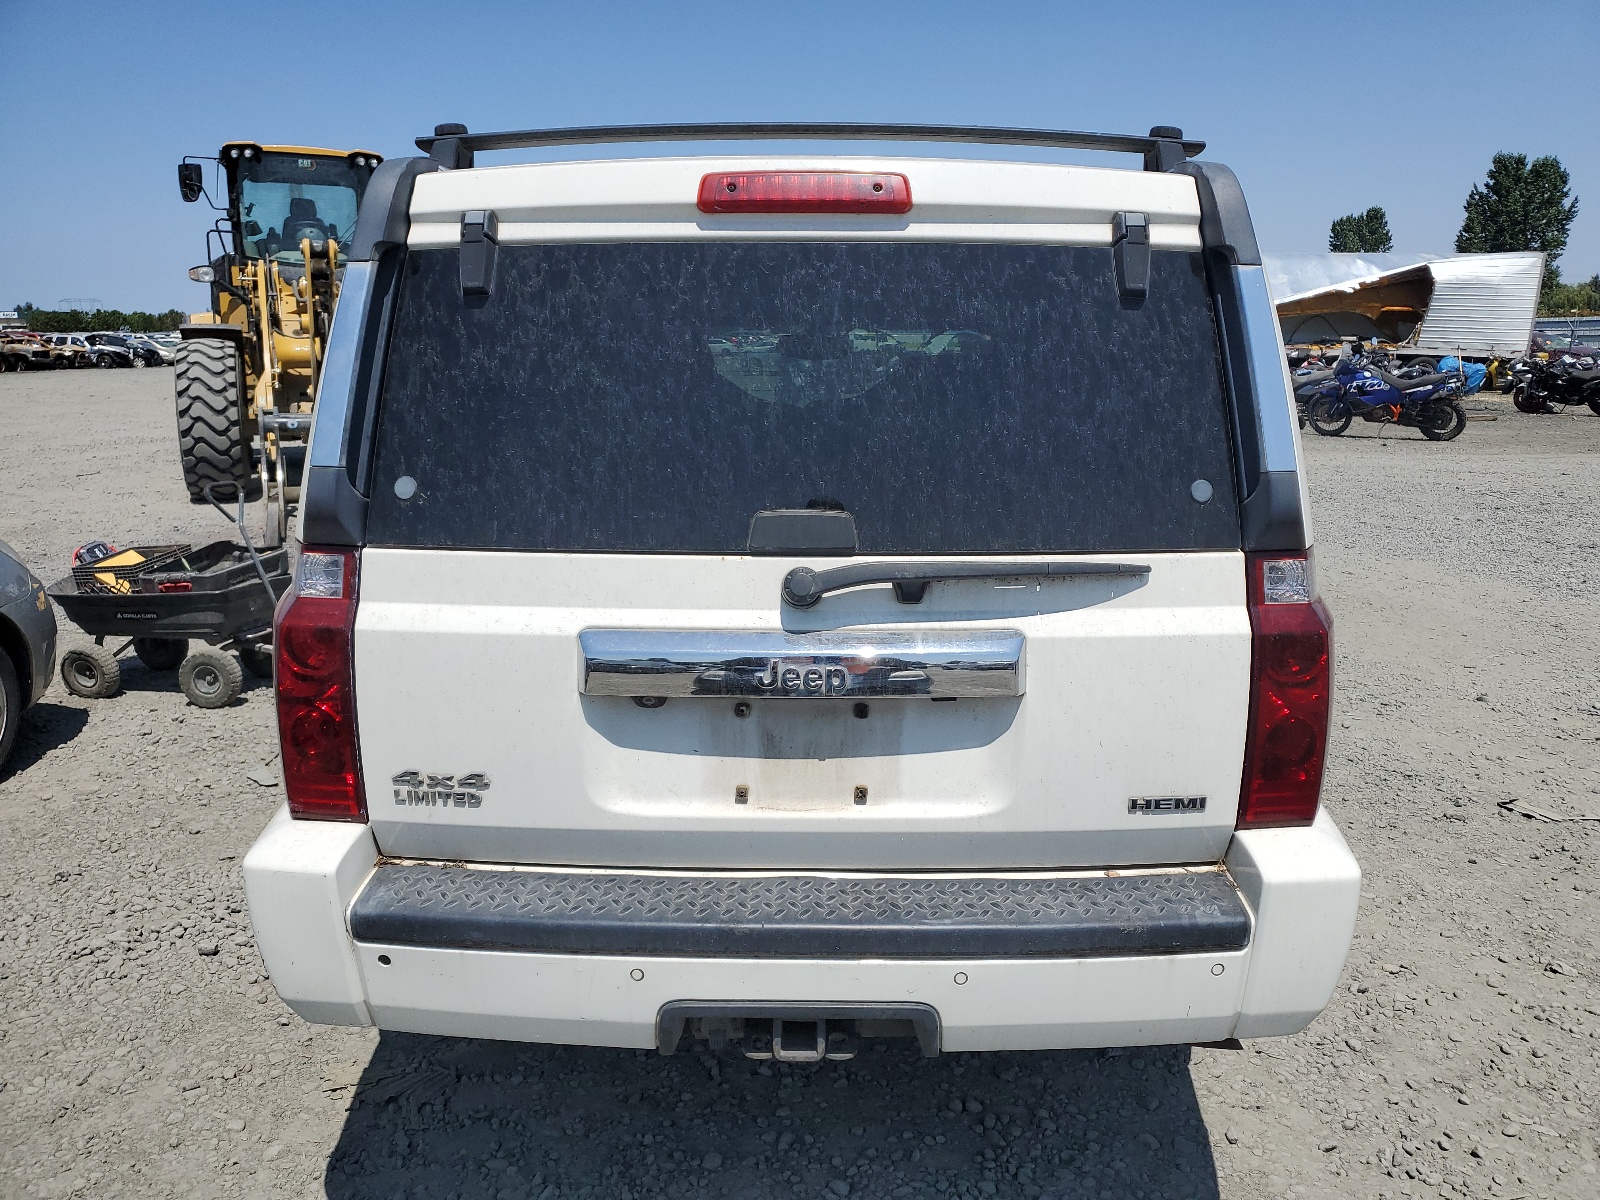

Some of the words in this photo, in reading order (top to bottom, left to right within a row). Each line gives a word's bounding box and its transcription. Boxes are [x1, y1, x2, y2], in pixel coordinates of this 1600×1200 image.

[754, 658, 848, 697] Jeep
[393, 789, 482, 809] LIMITED
[1128, 795, 1207, 815] HEMI
